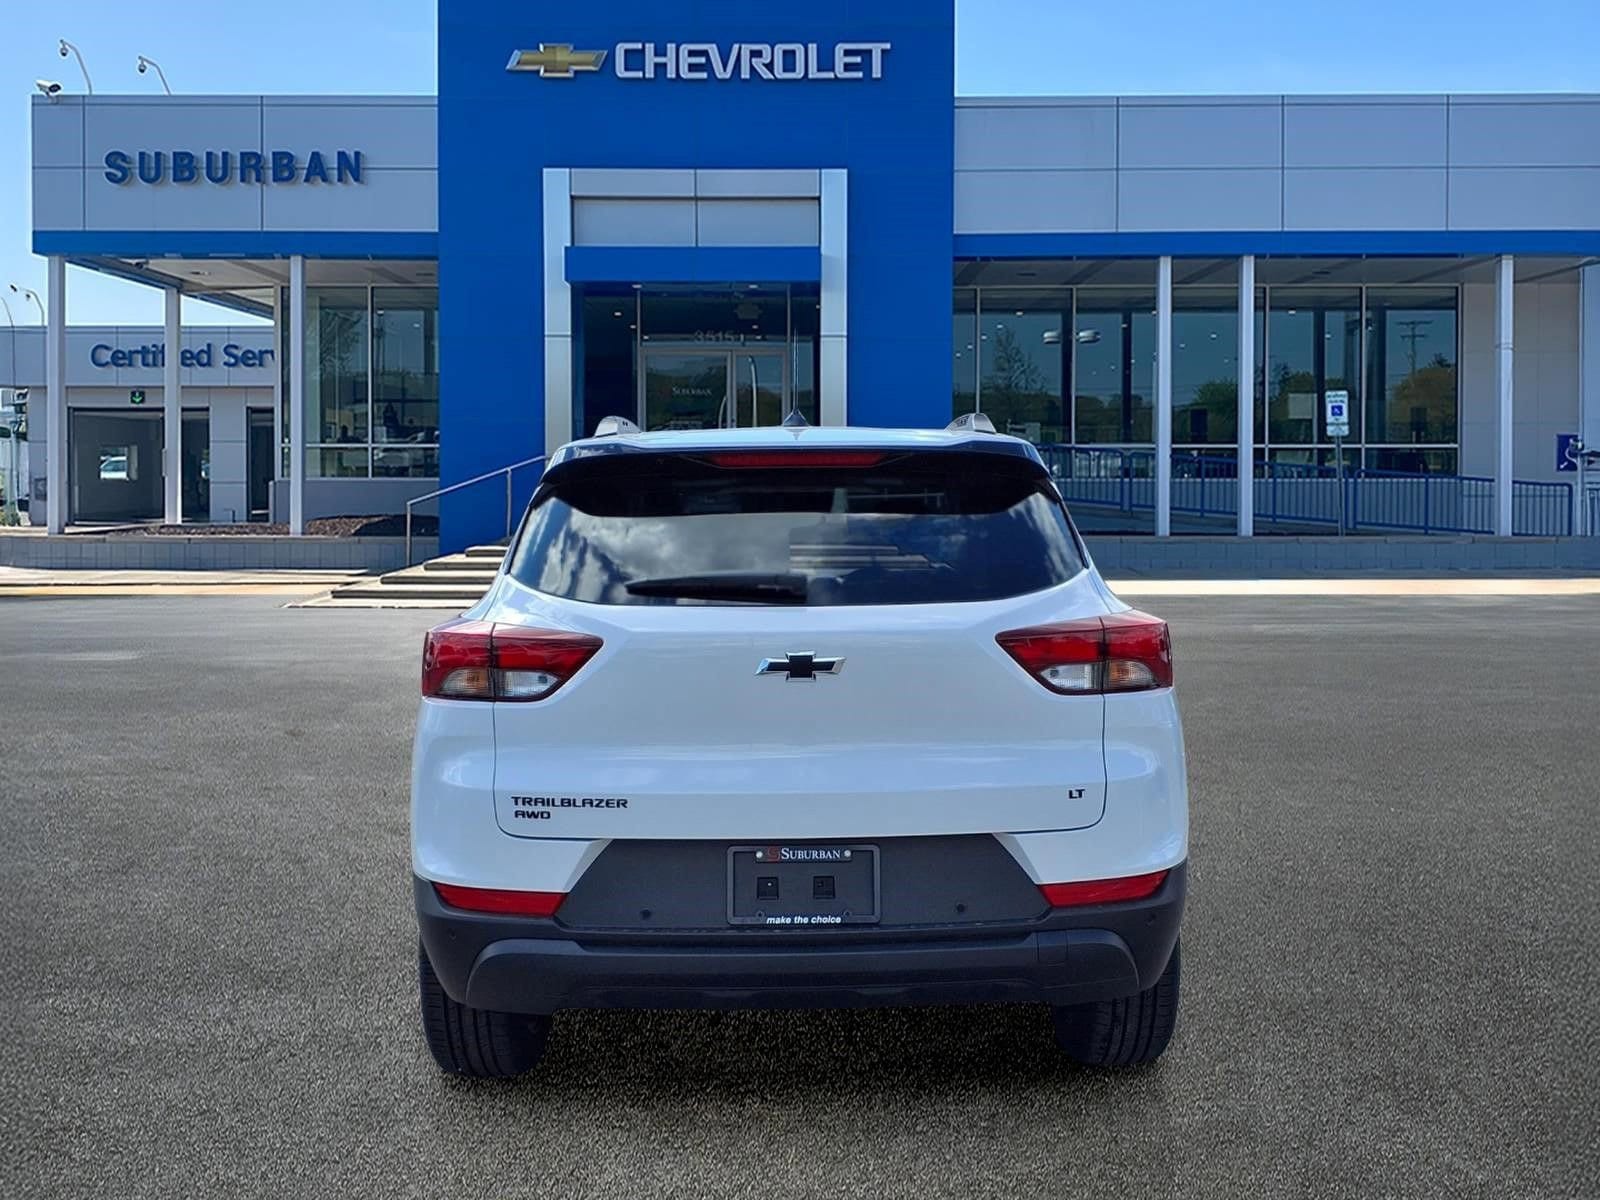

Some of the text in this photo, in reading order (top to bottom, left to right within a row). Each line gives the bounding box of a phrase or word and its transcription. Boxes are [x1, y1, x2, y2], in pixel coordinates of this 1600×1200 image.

[614, 42, 891, 80] CHEVROLET
[104, 150, 363, 185] SUBURBAN
[1068, 788, 1086, 799] LT
[511, 796, 628, 809] TRAILBLAZER
[514, 809, 551, 820] AWD
[781, 848, 841, 860] SUBURBAN
[766, 914, 841, 924] make the choice
